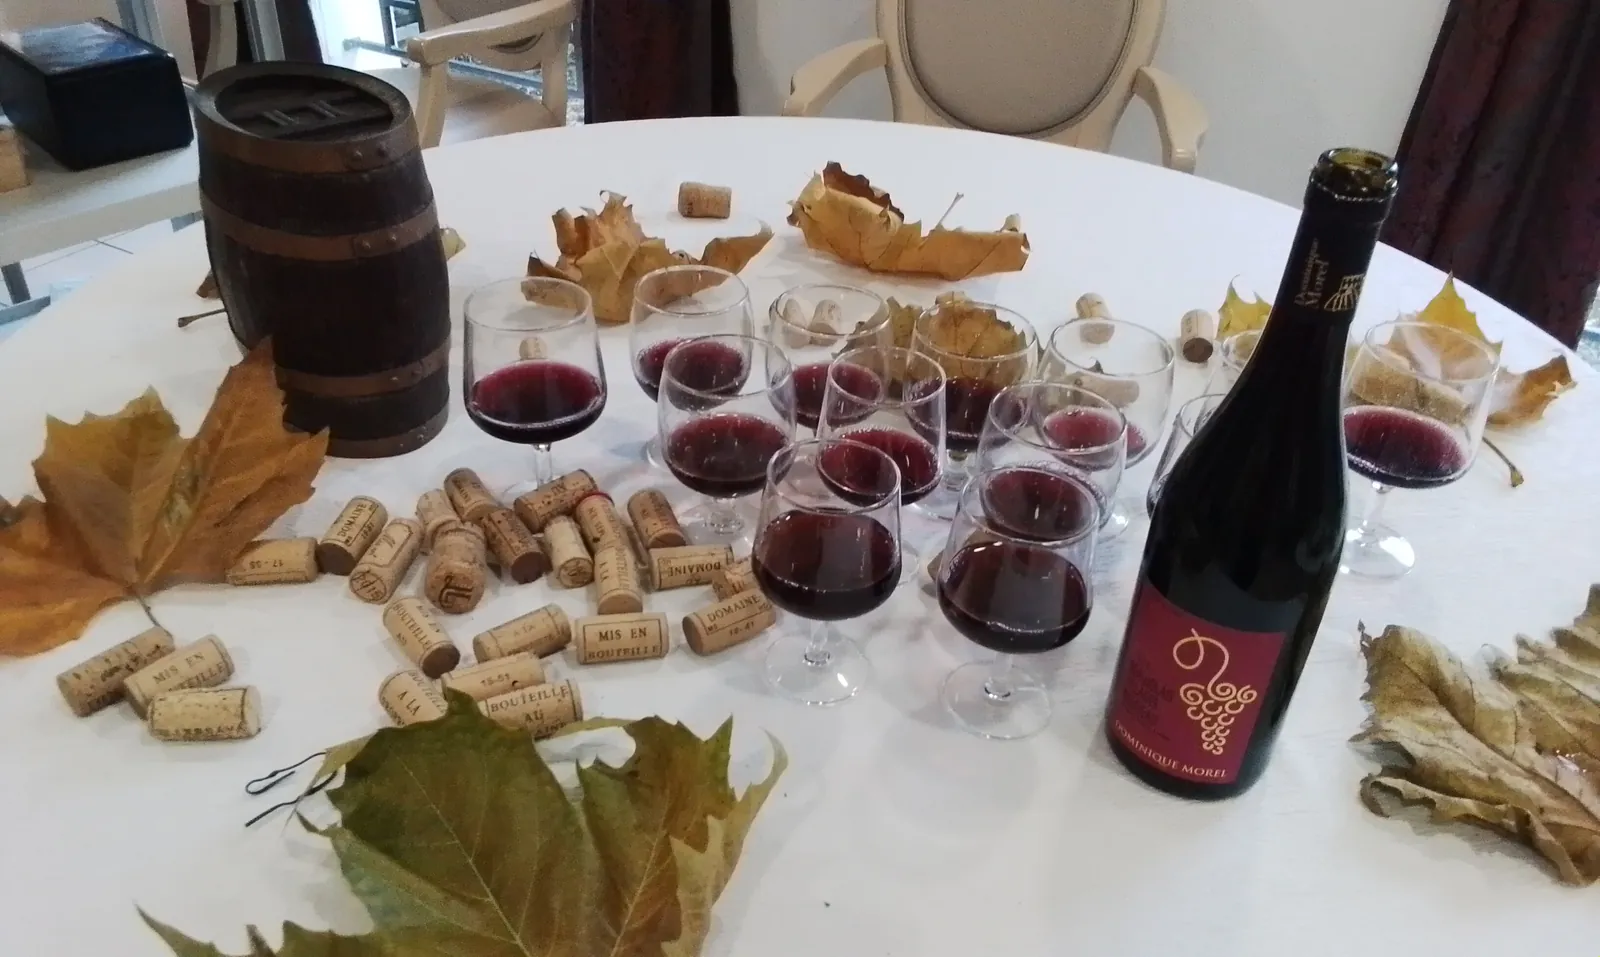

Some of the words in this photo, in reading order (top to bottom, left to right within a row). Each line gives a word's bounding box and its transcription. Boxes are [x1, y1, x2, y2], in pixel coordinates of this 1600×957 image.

[1303, 259, 1330, 309] Morel
[336, 503, 367, 539] DOMAINE
[667, 562, 722, 577] DOMAINE
[706, 596, 761, 621] DOMAINE
[598, 629, 623, 642] MIS
[630, 626, 648, 639] EN
[152, 664, 179, 684] MIS
[185, 651, 206, 668] EN
[397, 689, 406, 701] A
[405, 700, 422, 717] LA
[490, 684, 570, 713] BOUTEILLE
[524, 709, 544, 723] AU
[1115, 720, 1180, 770] DOMINIQUE
[1182, 765, 1227, 778] MOREL
